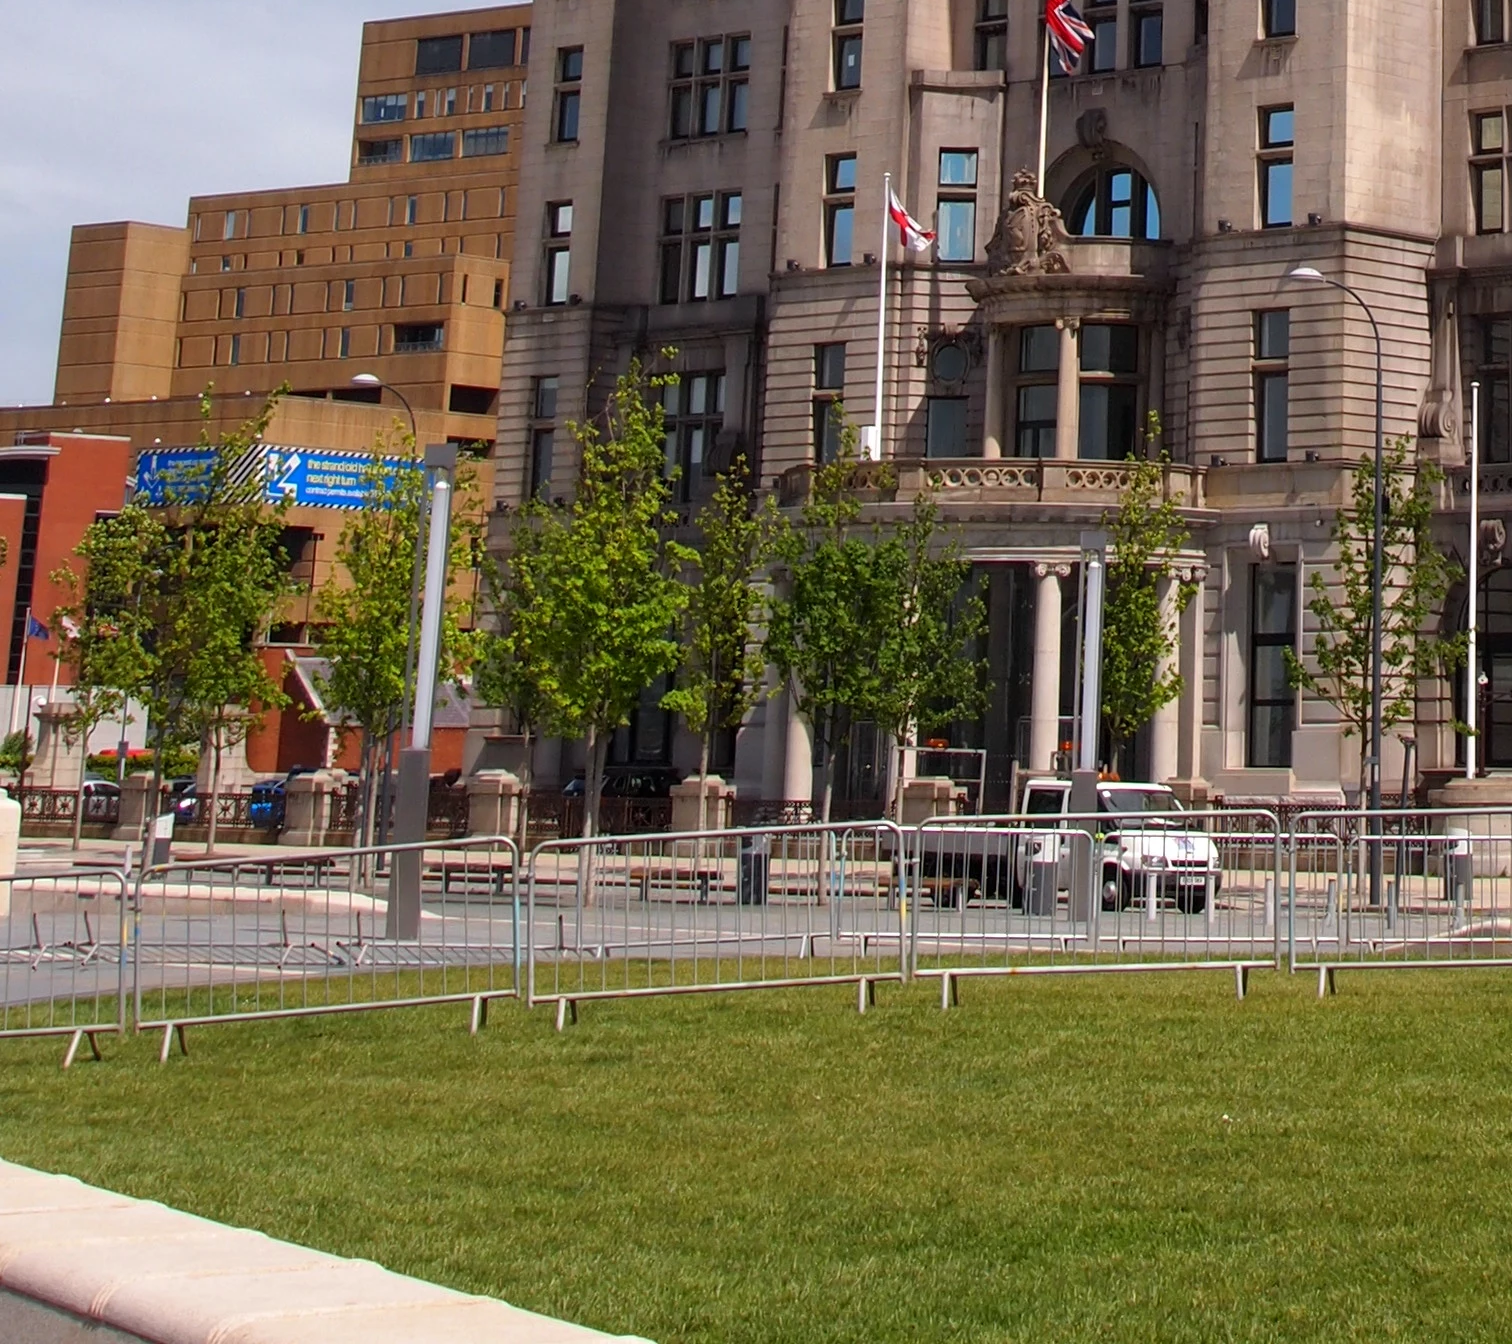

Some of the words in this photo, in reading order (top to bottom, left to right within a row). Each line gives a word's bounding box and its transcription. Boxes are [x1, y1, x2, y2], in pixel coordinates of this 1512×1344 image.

[306, 474, 323, 484] next
[324, 474, 340, 487] right
[341, 475, 356, 486] turn
